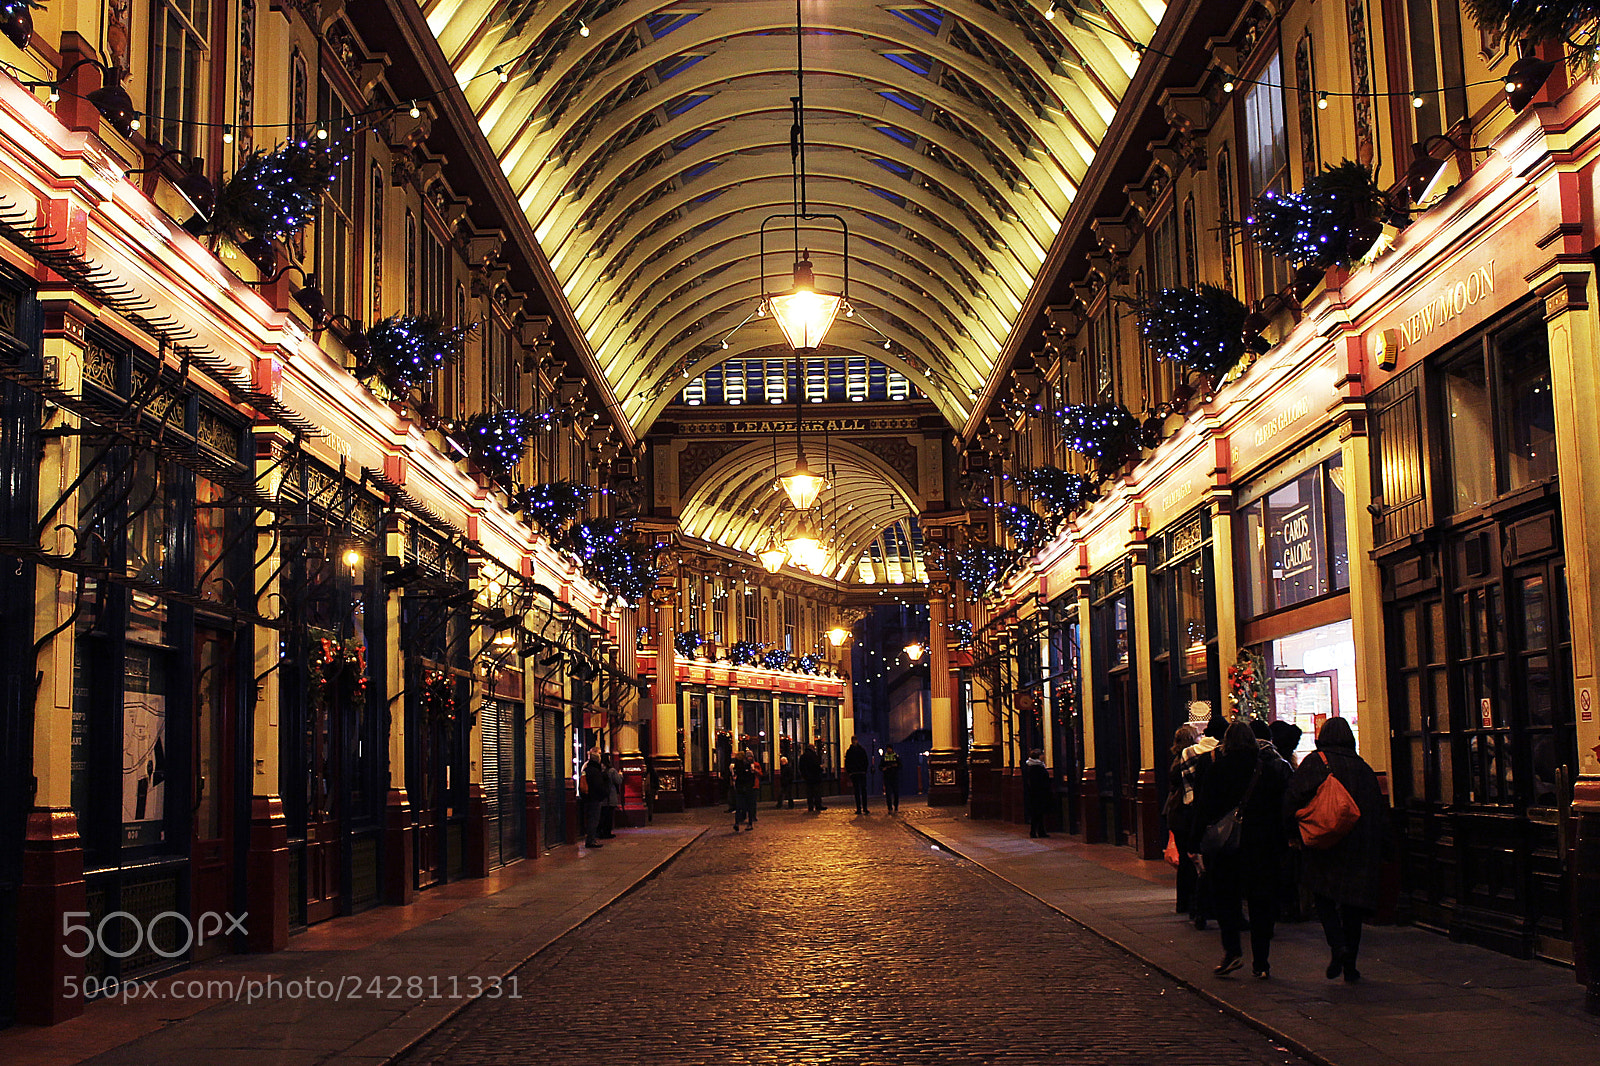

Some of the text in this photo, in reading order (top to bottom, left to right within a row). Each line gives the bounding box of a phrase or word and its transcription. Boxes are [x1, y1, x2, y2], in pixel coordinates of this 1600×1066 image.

[1400, 259, 1495, 352] NEW MOON
[1254, 396, 1309, 447] CARDS GALORE
[1284, 516, 1309, 544] CARDS
[1283, 540, 1312, 570] GALORE
